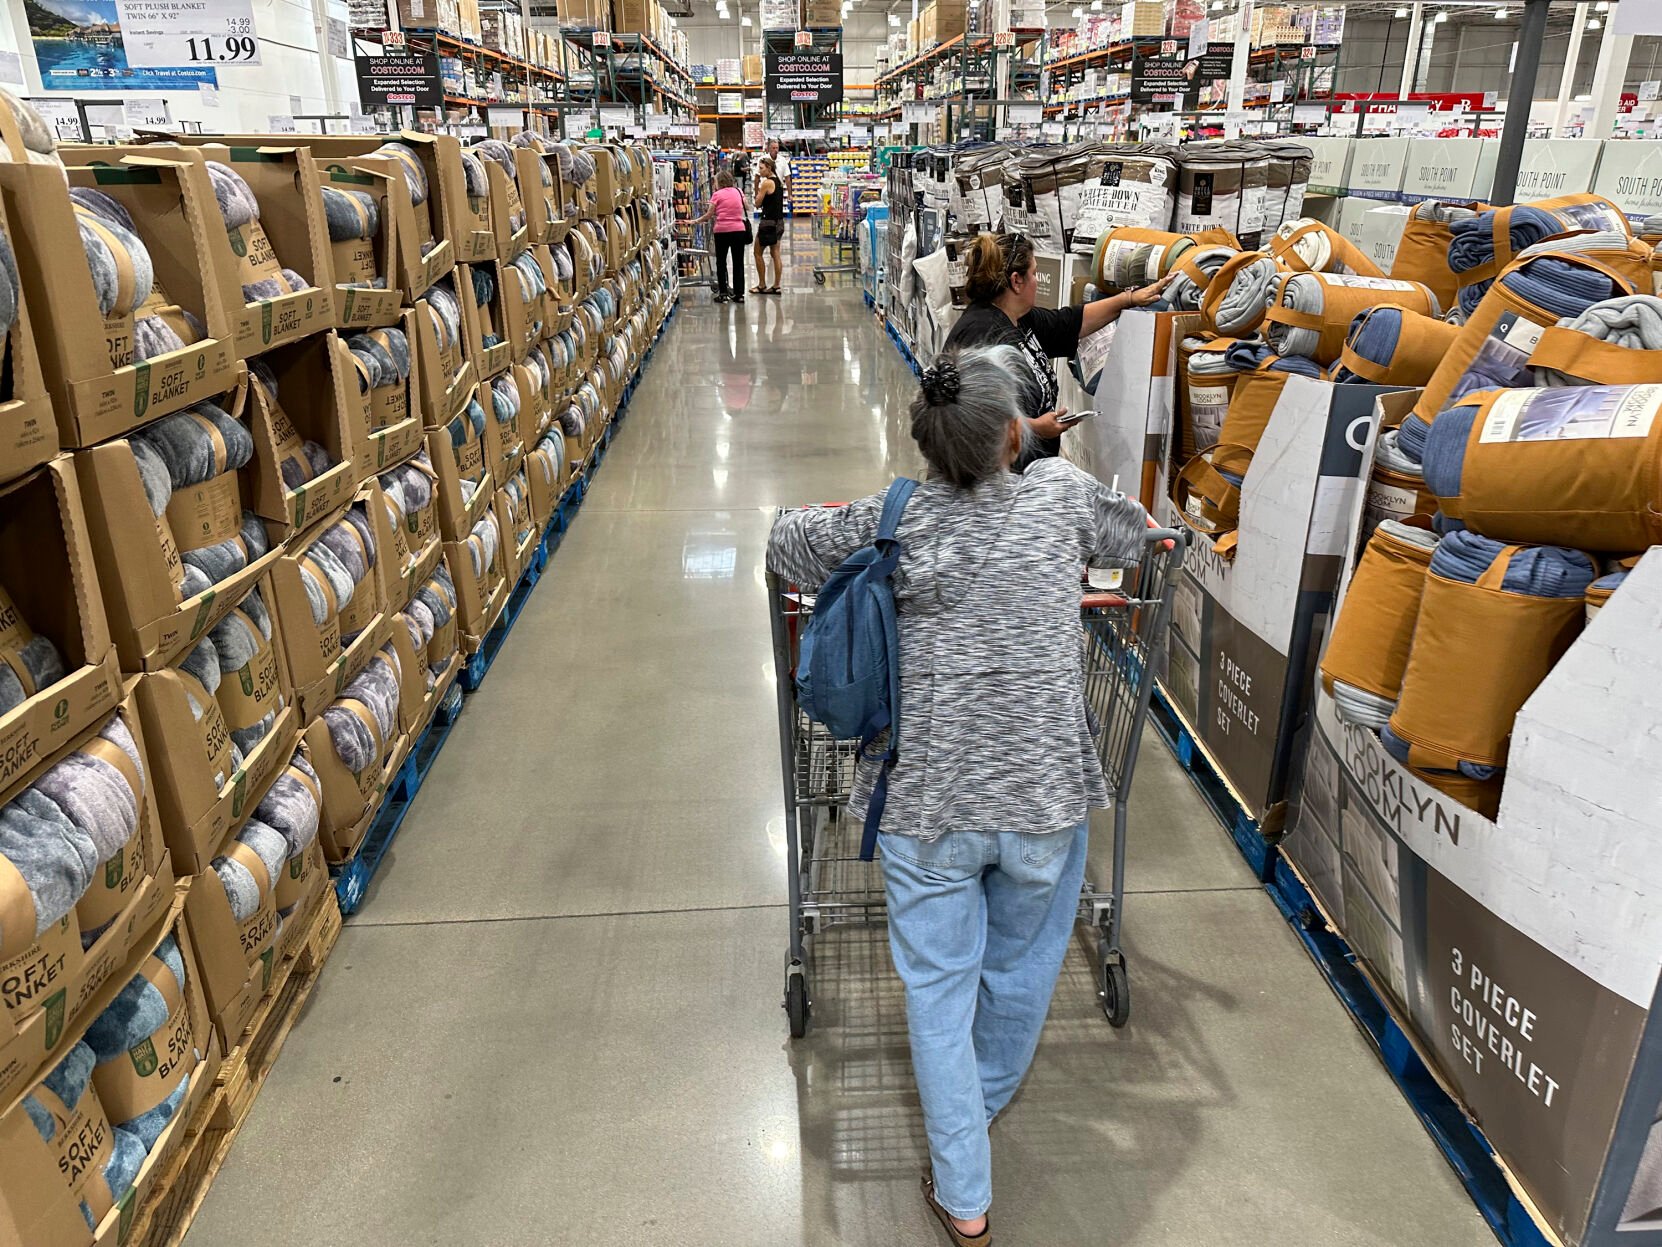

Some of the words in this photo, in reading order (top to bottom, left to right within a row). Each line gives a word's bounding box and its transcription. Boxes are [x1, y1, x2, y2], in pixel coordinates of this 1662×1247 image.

[124, 3, 143, 11] SOFT
[144, 3, 170, 11] PLUSH
[171, 2, 206, 10] BLANKET
[226, 18, 250, 26] 14.99
[227, 26, 250, 34] -3.00
[185, 37, 256, 61] 11.99
[370, 66, 425, 74] COSTCO.COM
[778, 64, 830, 72] COSTCO.COM
[1143, 69, 1184, 77] COSTCO.CO
[56, 117, 78, 126] 14.99
[145, 117, 166, 125] 14.99
[1361, 163, 1377, 177] SOUTH
[1377, 163, 1391, 177] POINT
[1418, 166, 1439, 181] SOUTH
[1440, 167, 1459, 182] POINT
[1516, 170, 1539, 187] OUTH
[1540, 172, 1567, 190] POINT
[1616, 176, 1647, 195] SOUTH
[1111, 189, 1140, 203] DOWN
[1350, 223, 1364, 236] SOUT
[1373, 242, 1395, 260] SOUTH
[1036, 271, 1051, 284] KING
[279, 310, 297, 324] SOFT
[274, 319, 302, 336] BLANKET
[1499, 323, 1509, 333] Q
[161, 371, 185, 389] SOFT
[102, 390, 116, 399] TWIN
[152, 380, 190, 405] BLANKET
[311, 493, 328, 509] SOFT
[1372, 490, 1407, 505] OOKLYN
[305, 500, 330, 521] BLANKET
[1170, 511, 1226, 581] BROKLYN
[1183, 547, 1206, 585] OOM
[164, 630, 179, 640] TWIN
[1219, 650, 1225, 671] 3
[1226, 657, 1252, 697] PIECE
[1218, 679, 1260, 736] COVERLET
[1217, 706, 1231, 736] SET
[1, 737, 40, 781] ANKET
[1335, 703, 1460, 847] BROOKLYN
[1346, 738, 1401, 834] LOOM
[239, 911, 271, 945] SOFT
[1451, 947, 1463, 976] 3
[1470, 963, 1537, 1042] PIECE
[1450, 986, 1560, 1108] COVERLET
[1451, 1023, 1484, 1075] SET
[58, 1118, 92, 1174] SOFT
[70, 1119, 106, 1185] ANKET
